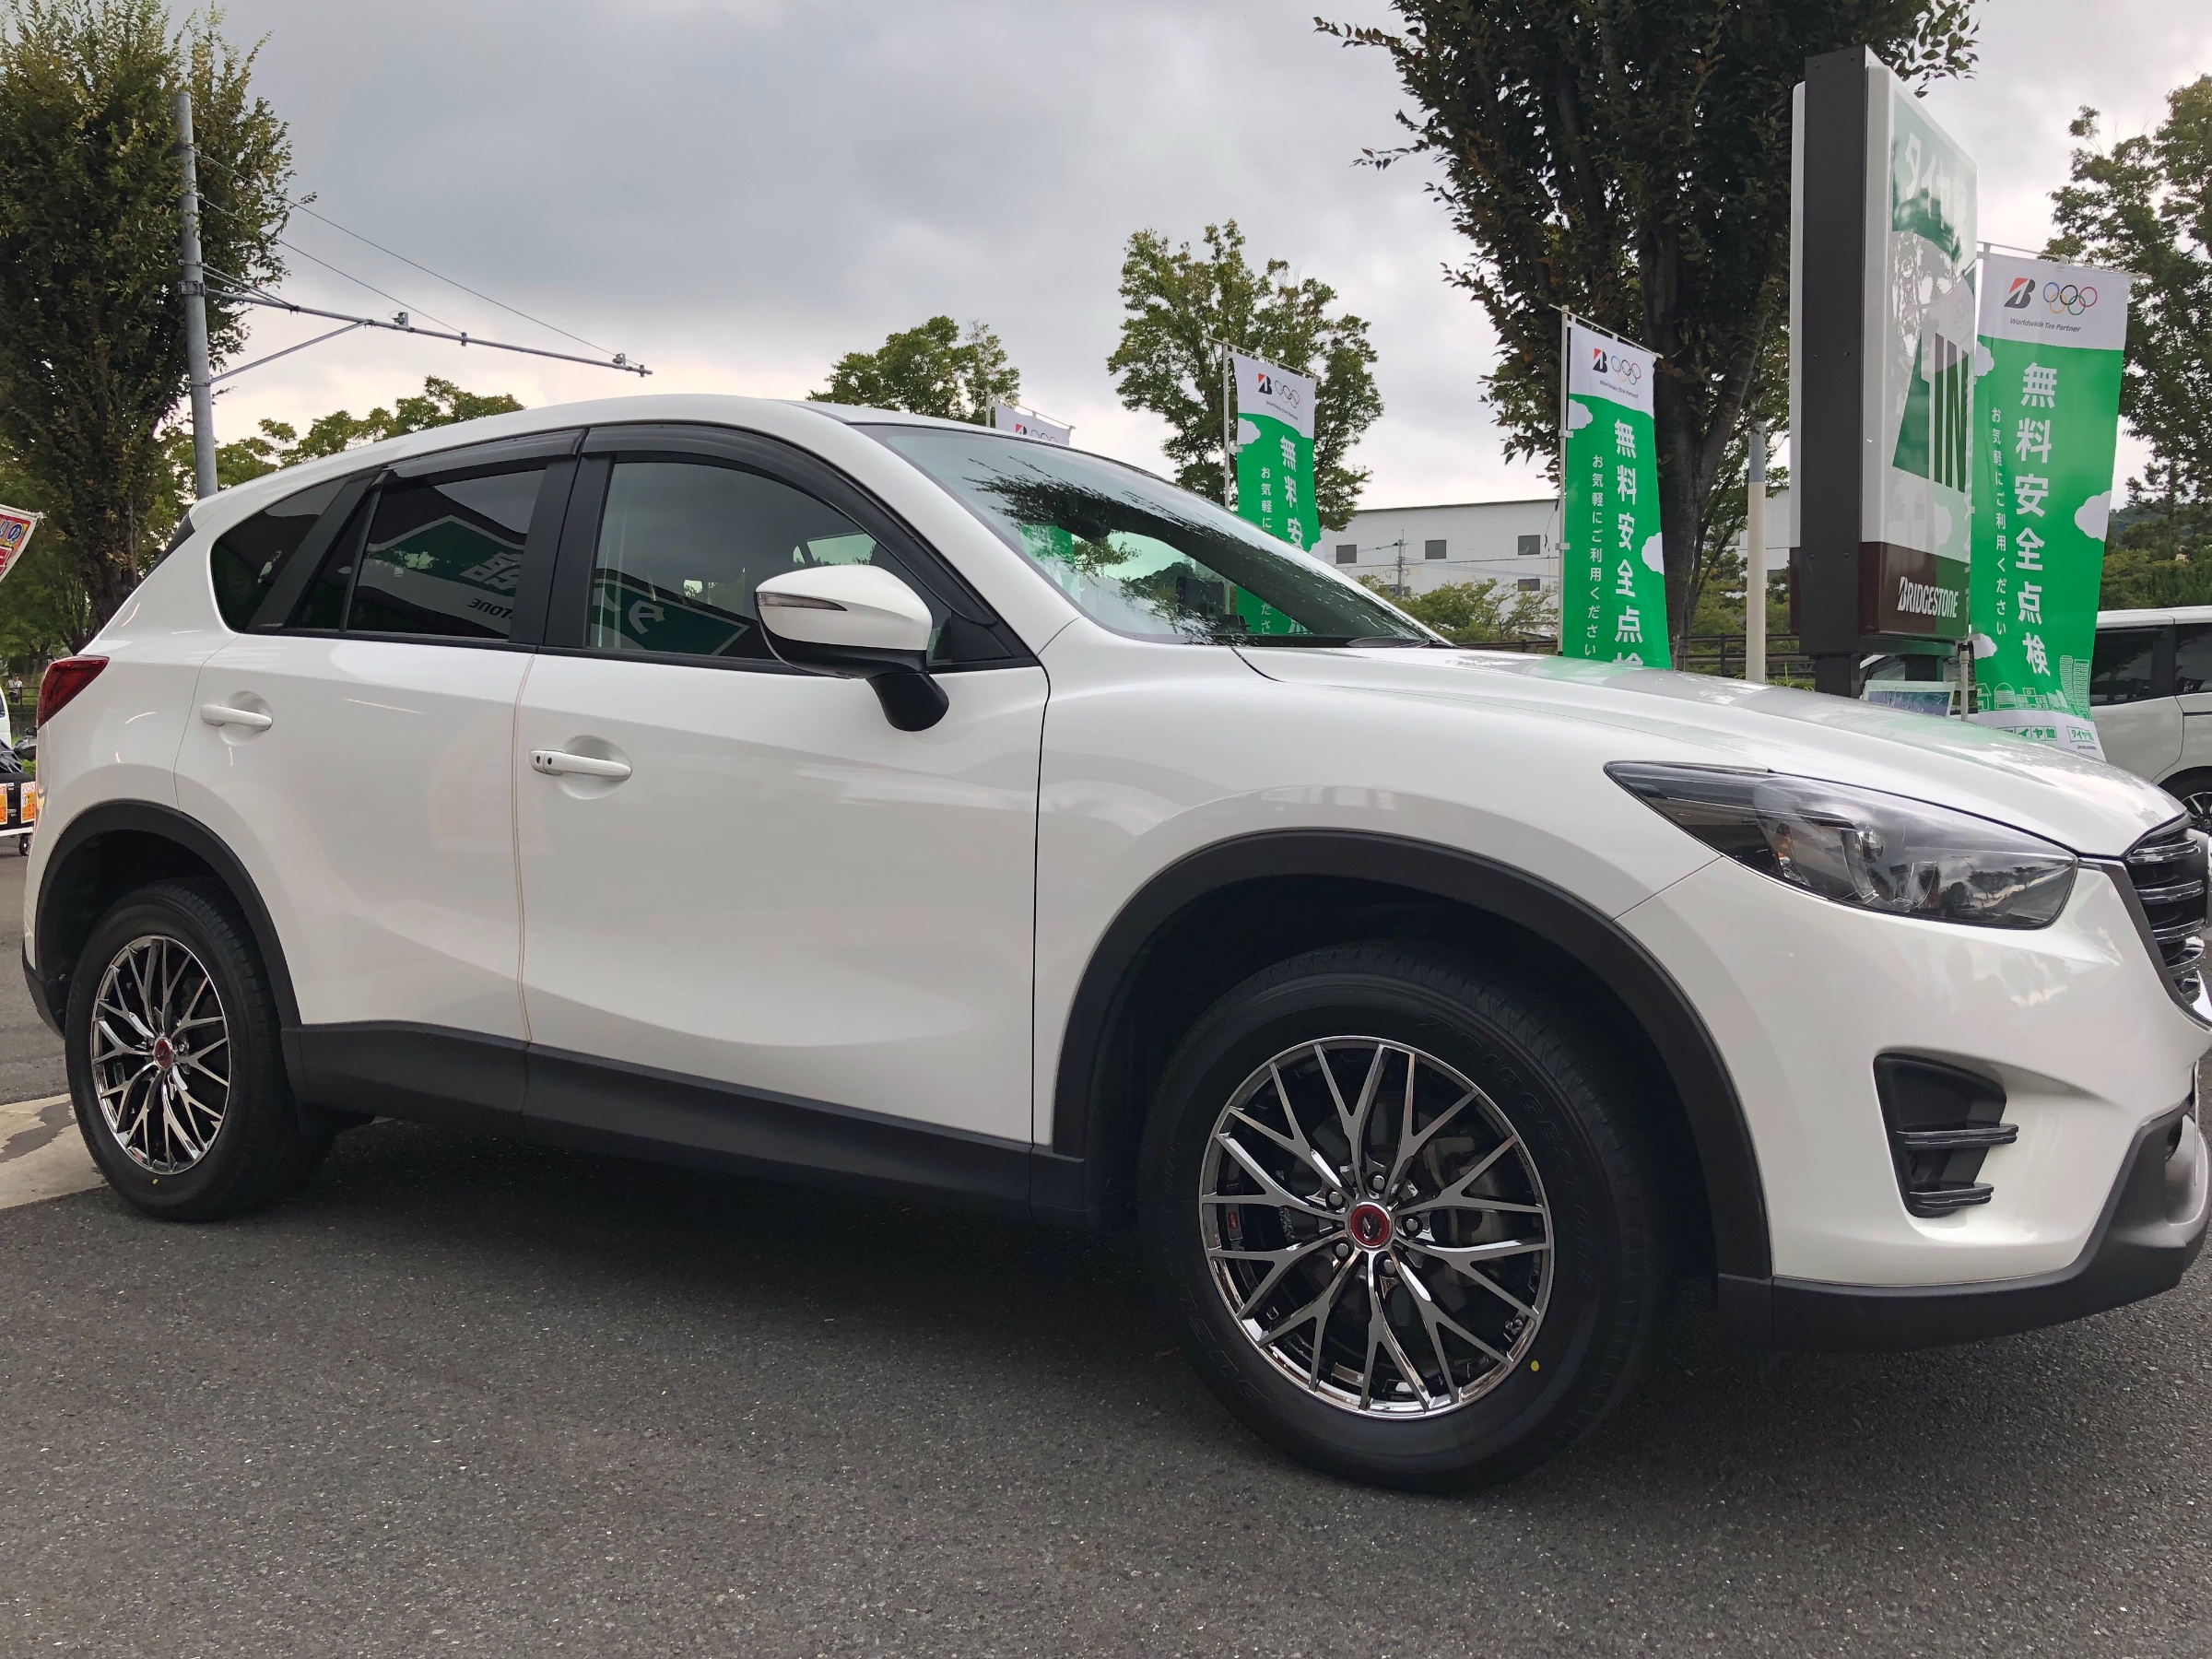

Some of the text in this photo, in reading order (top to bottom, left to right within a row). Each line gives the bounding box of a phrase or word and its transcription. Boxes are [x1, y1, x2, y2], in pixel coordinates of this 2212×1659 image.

[2010, 318, 2081, 333] Worldwide Tire Partner
[1584, 454, 1605, 656] お気軽にご利用ください
[1897, 576, 1959, 618] BRIDGESTONE
[1992, 406, 2007, 636] お気軽にご利用ください
[2014, 362, 2058, 677] 無料安全点検
